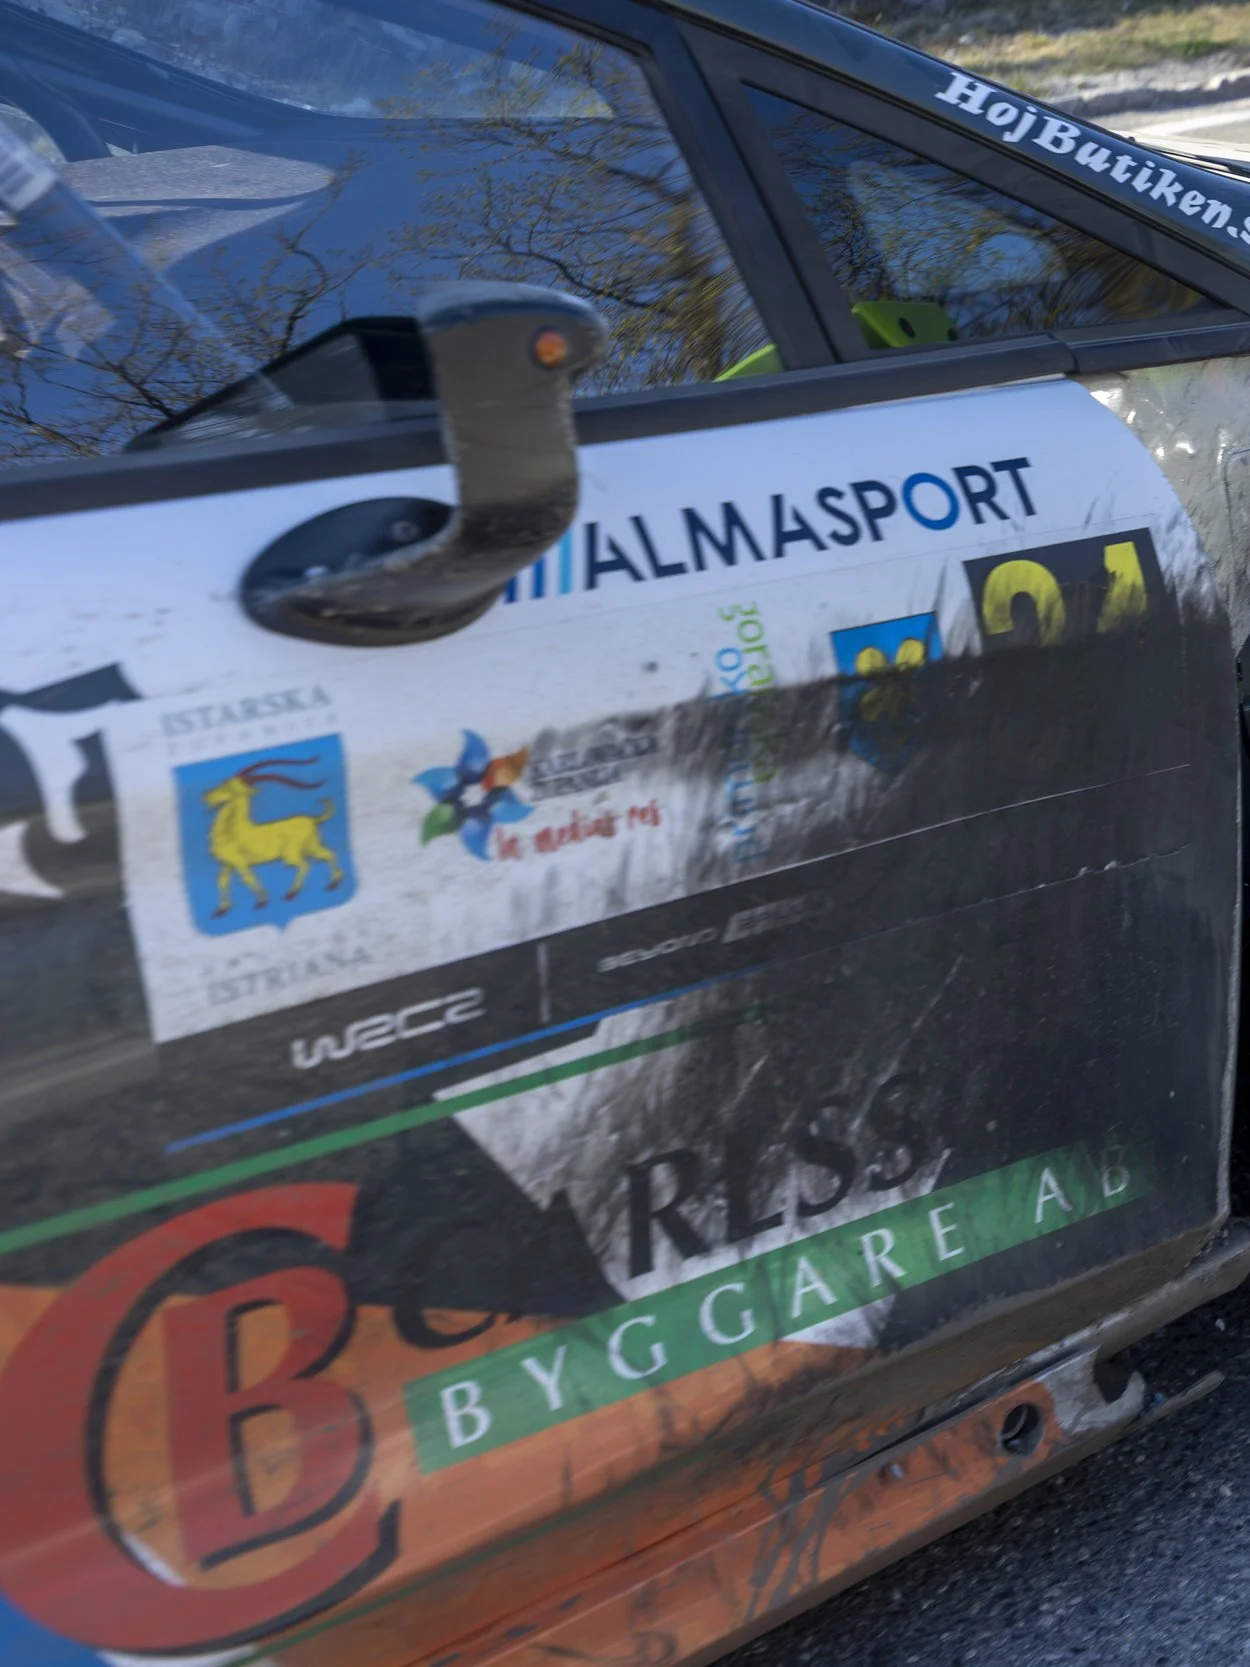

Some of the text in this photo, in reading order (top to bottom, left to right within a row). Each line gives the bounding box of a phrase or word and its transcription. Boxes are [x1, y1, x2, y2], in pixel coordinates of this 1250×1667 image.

[584, 456, 1040, 592] ALMASPORT
[161, 686, 334, 737] ISTARSKA
[291, 986, 486, 1069] WRC2
[439, 1158, 1132, 1449] BYGGARE AB
